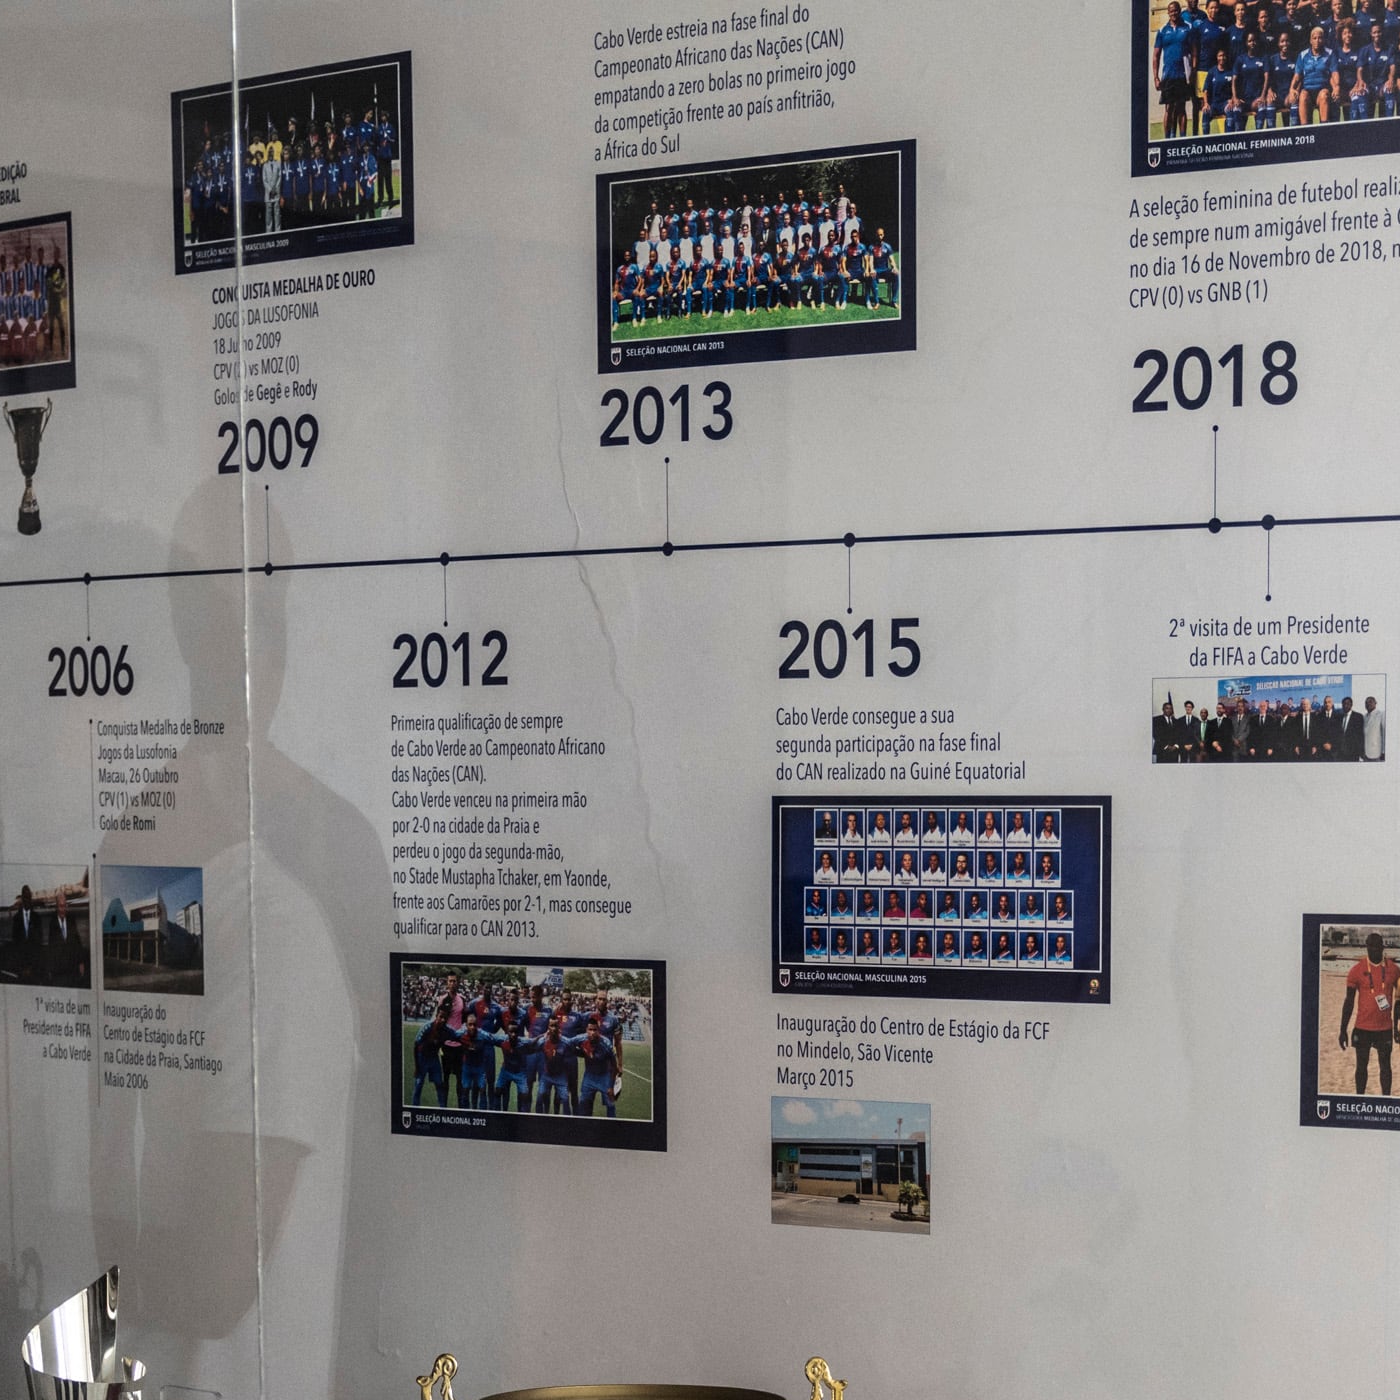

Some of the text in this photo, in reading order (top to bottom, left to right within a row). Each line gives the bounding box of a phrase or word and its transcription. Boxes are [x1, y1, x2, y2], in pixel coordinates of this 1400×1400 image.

[593, 2, 809, 50] Cabo Verde estreia na fase final do
[1128, 198, 1140, 218] A
[1142, 194, 1198, 220] seleção
[1202, 188, 1272, 212] feminina
[1277, 183, 1297, 205] de
[1300, 177, 1357, 203] futebol
[273, 275, 323, 297] MEDALHA
[326, 273, 340, 289] DE
[343, 269, 375, 288] OURO
[625, 340, 724, 357] SELEÇÃO NACIONAL CAN 2013
[1131, 339, 1298, 413] 2018
[599, 380, 733, 447] 2013
[216, 413, 319, 489] 2009
[392, 629, 508, 688] 2012
[778, 617, 921, 679] 2015
[47, 644, 134, 697] 2006
[96, 718, 224, 740] Conquista Medalha de Bronze
[390, 711, 567, 735] Primeira qualificação de sempre
[775, 705, 954, 729] Cabo Verde consegue a sua
[103, 1069, 149, 1090] Maio 2006
[1336, 1102, 1373, 1114] SELEÇÃO
